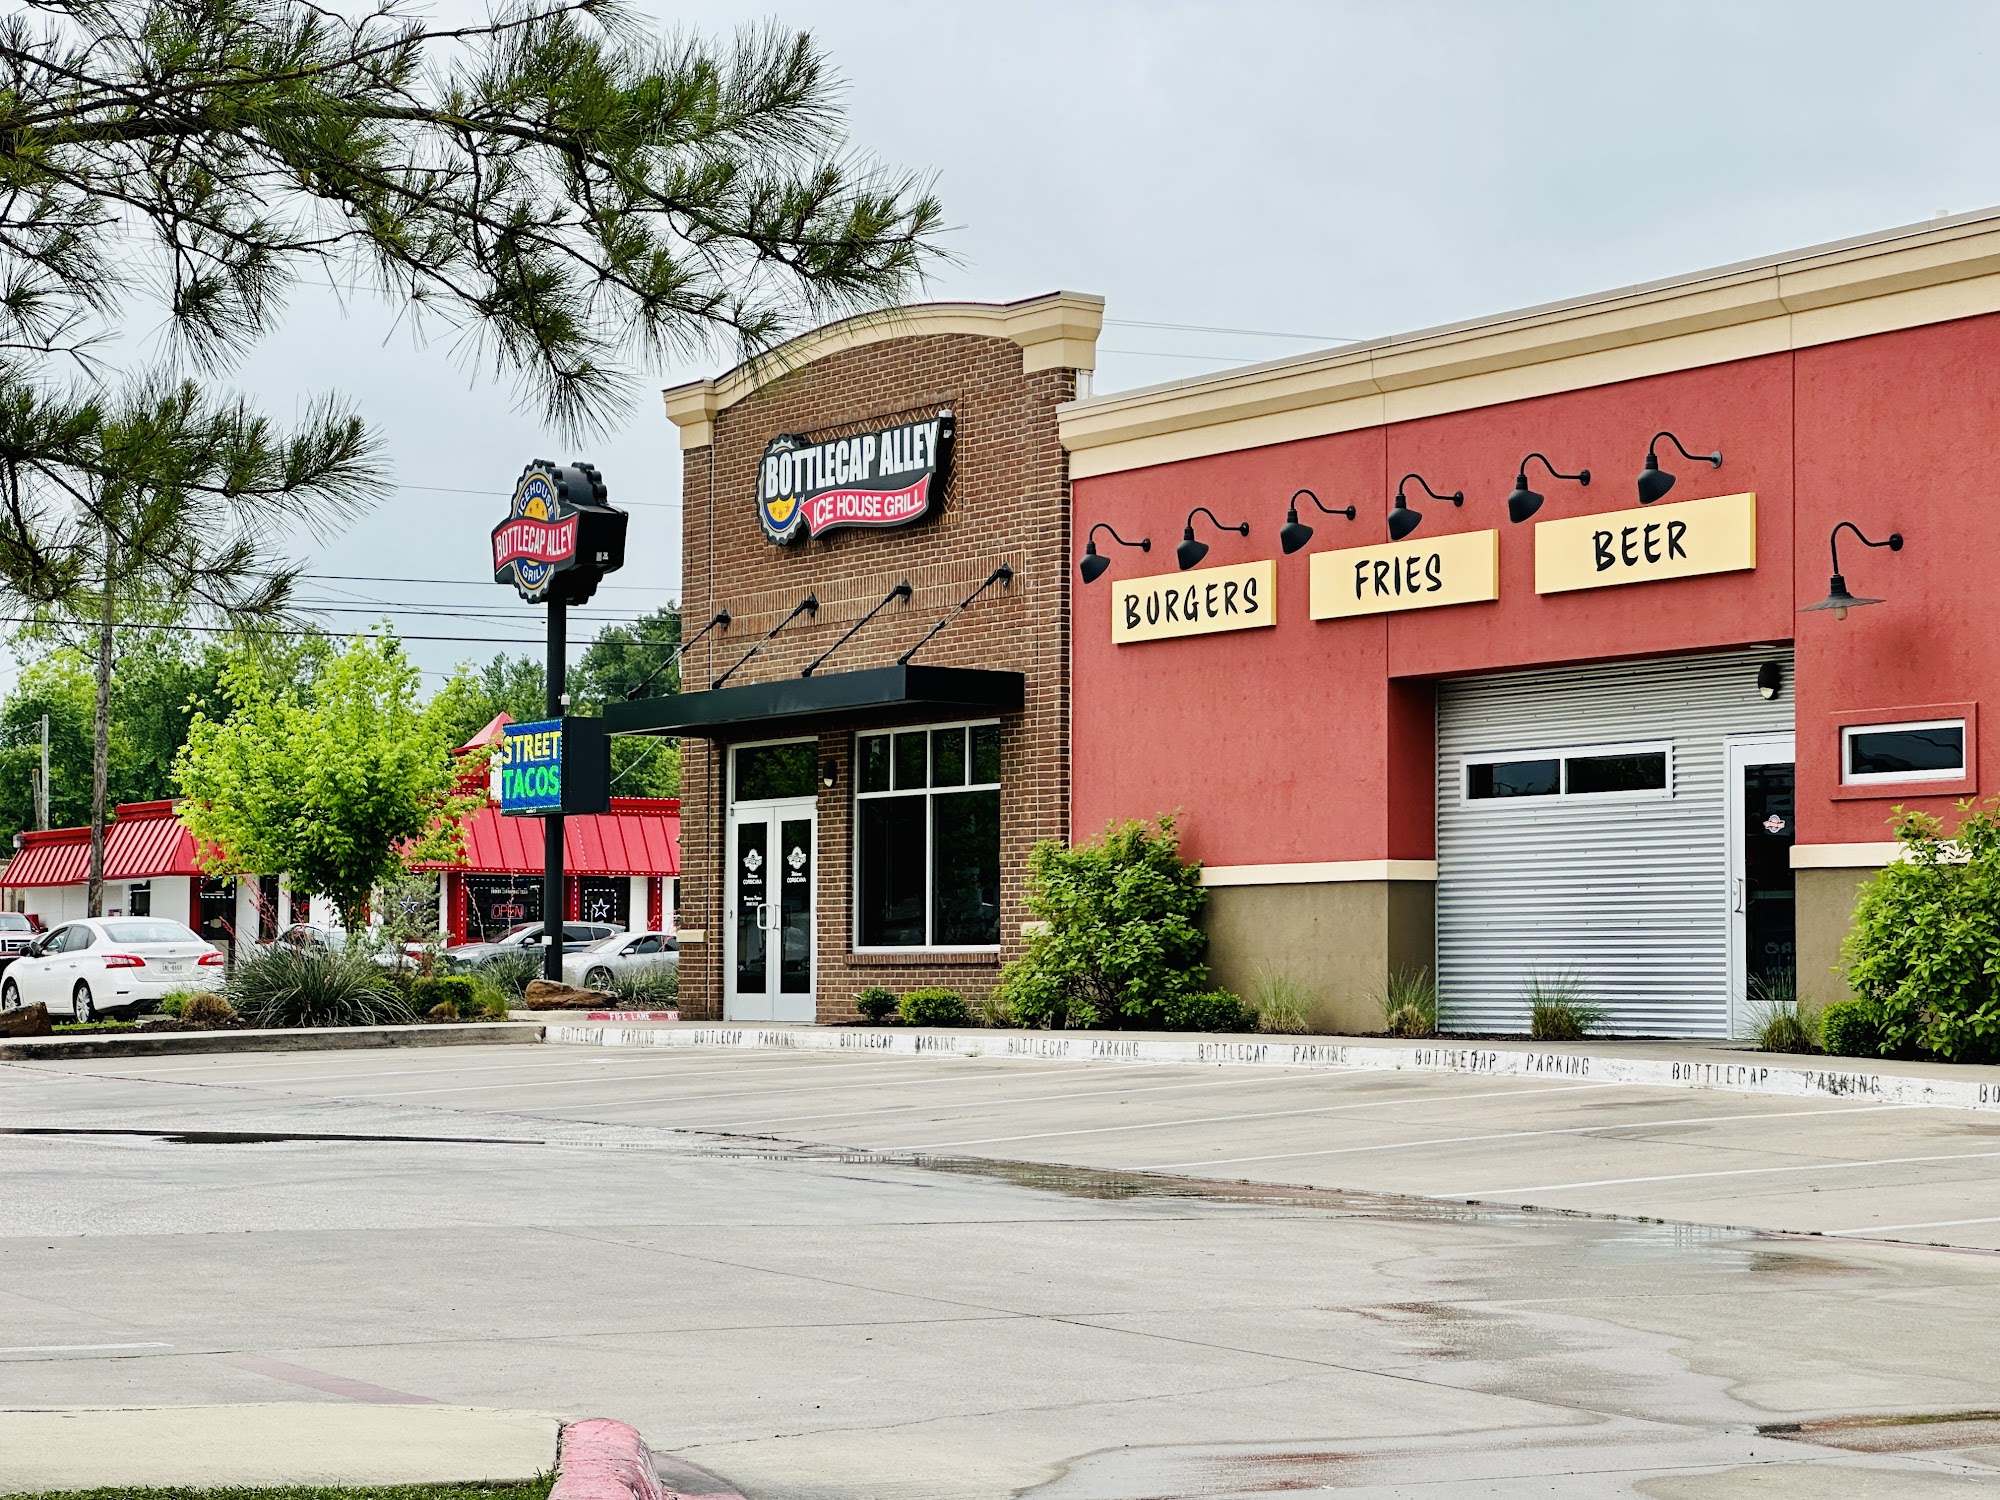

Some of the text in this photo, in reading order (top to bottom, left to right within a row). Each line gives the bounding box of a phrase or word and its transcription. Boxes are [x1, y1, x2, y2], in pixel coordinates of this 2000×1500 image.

[765, 421, 938, 499] BOTTLECAP ALLEY
[812, 489, 923, 529] ICE HOUSE GRILL
[495, 522, 573, 563] BOTTLECAP ALLEY
[1592, 520, 1688, 573] BEER
[522, 564, 545, 582] GRILL
[1354, 553, 1443, 600] FRIES
[1123, 576, 1260, 630] BURGERS
[503, 731, 561, 764] STREET
[502, 765, 560, 799] TACOS
[493, 904, 523, 919] OPEN
[610, 1012, 627, 1021] FIRE
[631, 1012, 650, 1020] LANE
[621, 1030, 655, 1045] PARKING
[694, 1031, 795, 1046] BOTTLECAP PARKING
[840, 1033, 894, 1049] BOTTLECAP
[1008, 1037, 1140, 1058] BOTTLECAP PARKING
[1198, 1043, 1348, 1063] BOTTLECAP PARKING
[1526, 1052, 1590, 1075] PARKING
[1672, 1062, 1881, 1096] BOTTLECAP PARKING
